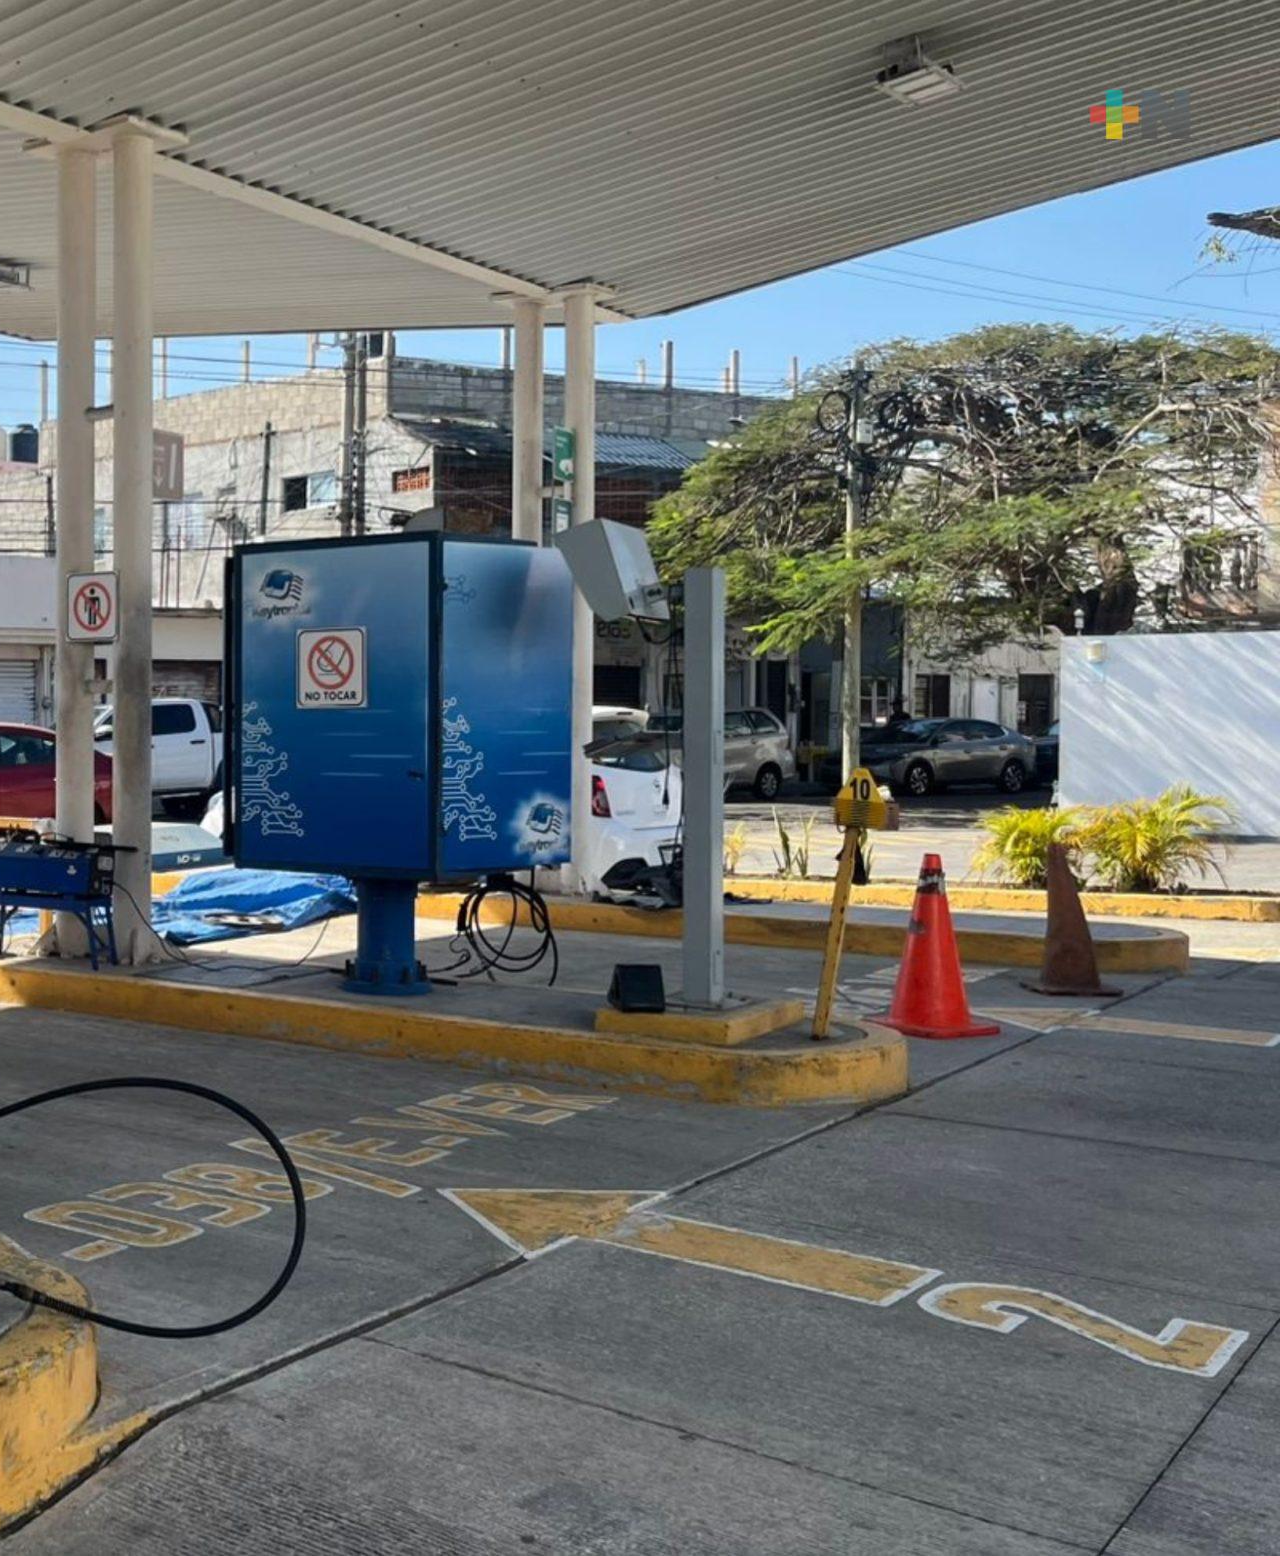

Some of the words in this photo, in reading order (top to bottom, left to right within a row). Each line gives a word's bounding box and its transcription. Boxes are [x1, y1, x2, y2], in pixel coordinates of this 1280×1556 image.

[305, 692, 321, 701] NO
[323, 690, 358, 701] TOCAR
[849, 778, 871, 801] 10
